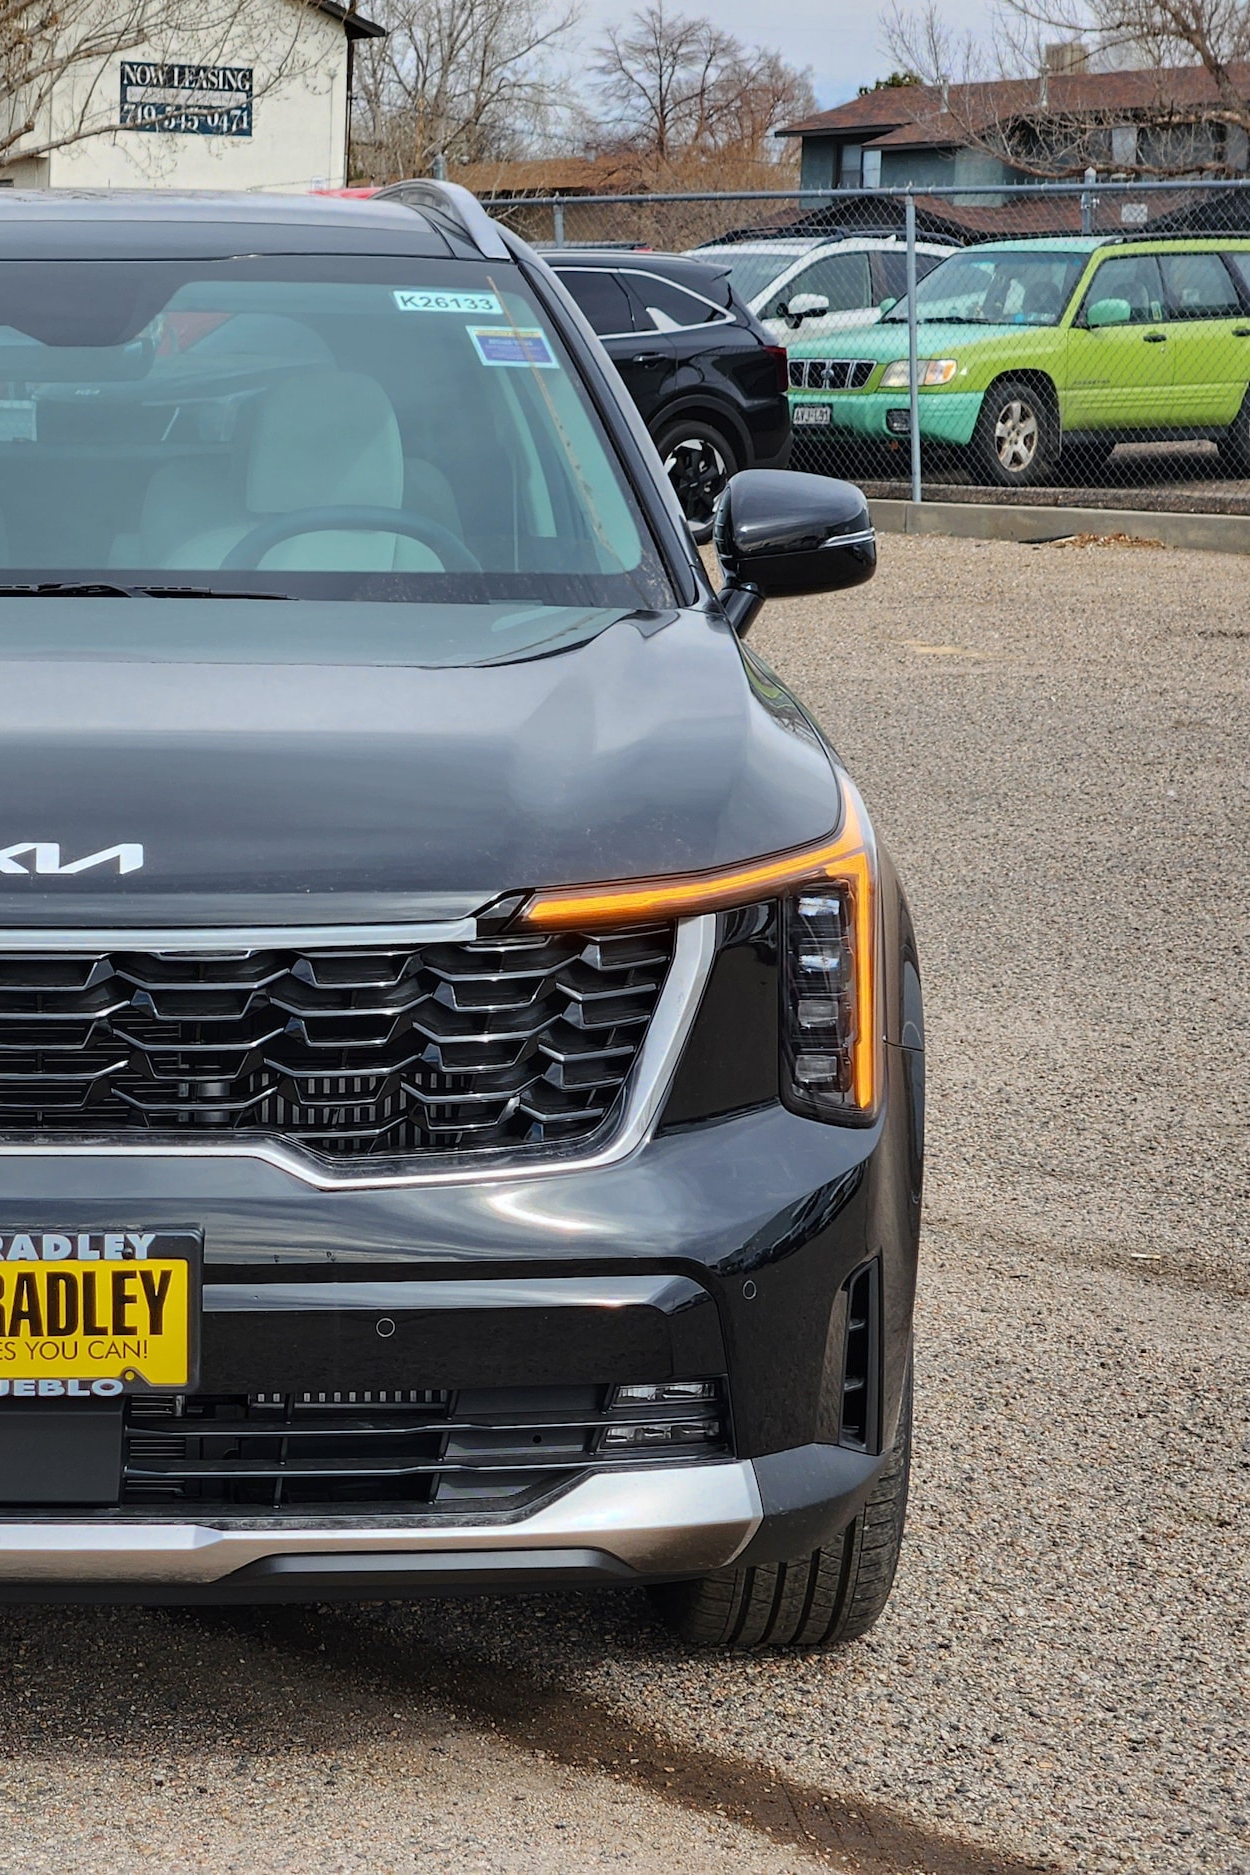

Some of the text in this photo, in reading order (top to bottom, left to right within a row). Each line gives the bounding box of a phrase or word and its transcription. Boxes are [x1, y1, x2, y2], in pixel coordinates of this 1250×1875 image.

[123, 64, 250, 90] NOW LEASING
[400, 295, 493, 310] K26133
[25, 1341, 78, 1361] YOU
[88, 1340, 148, 1360] CAN!
